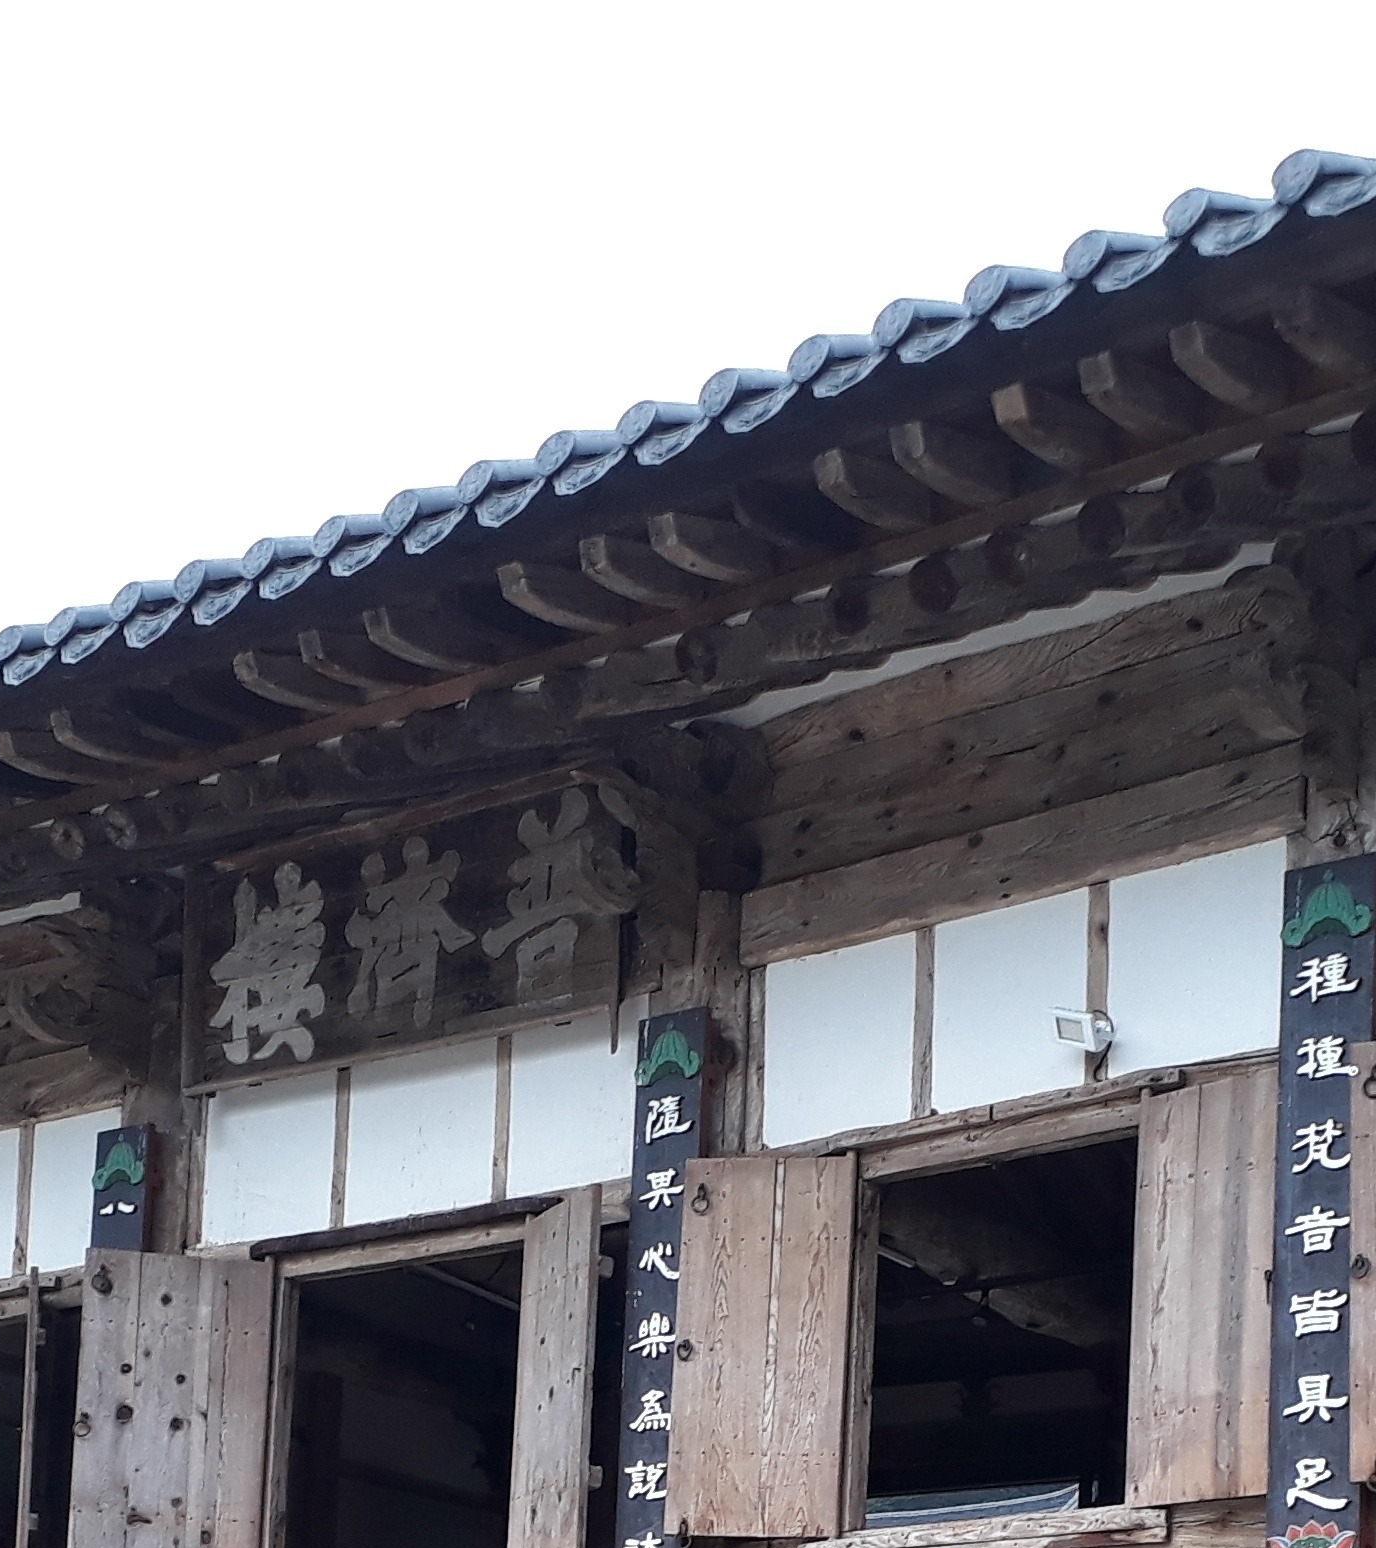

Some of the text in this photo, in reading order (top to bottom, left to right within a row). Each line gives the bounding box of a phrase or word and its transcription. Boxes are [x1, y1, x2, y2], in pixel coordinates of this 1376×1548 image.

[1282, 951, 1361, 1512] 種種梵音皆具足
